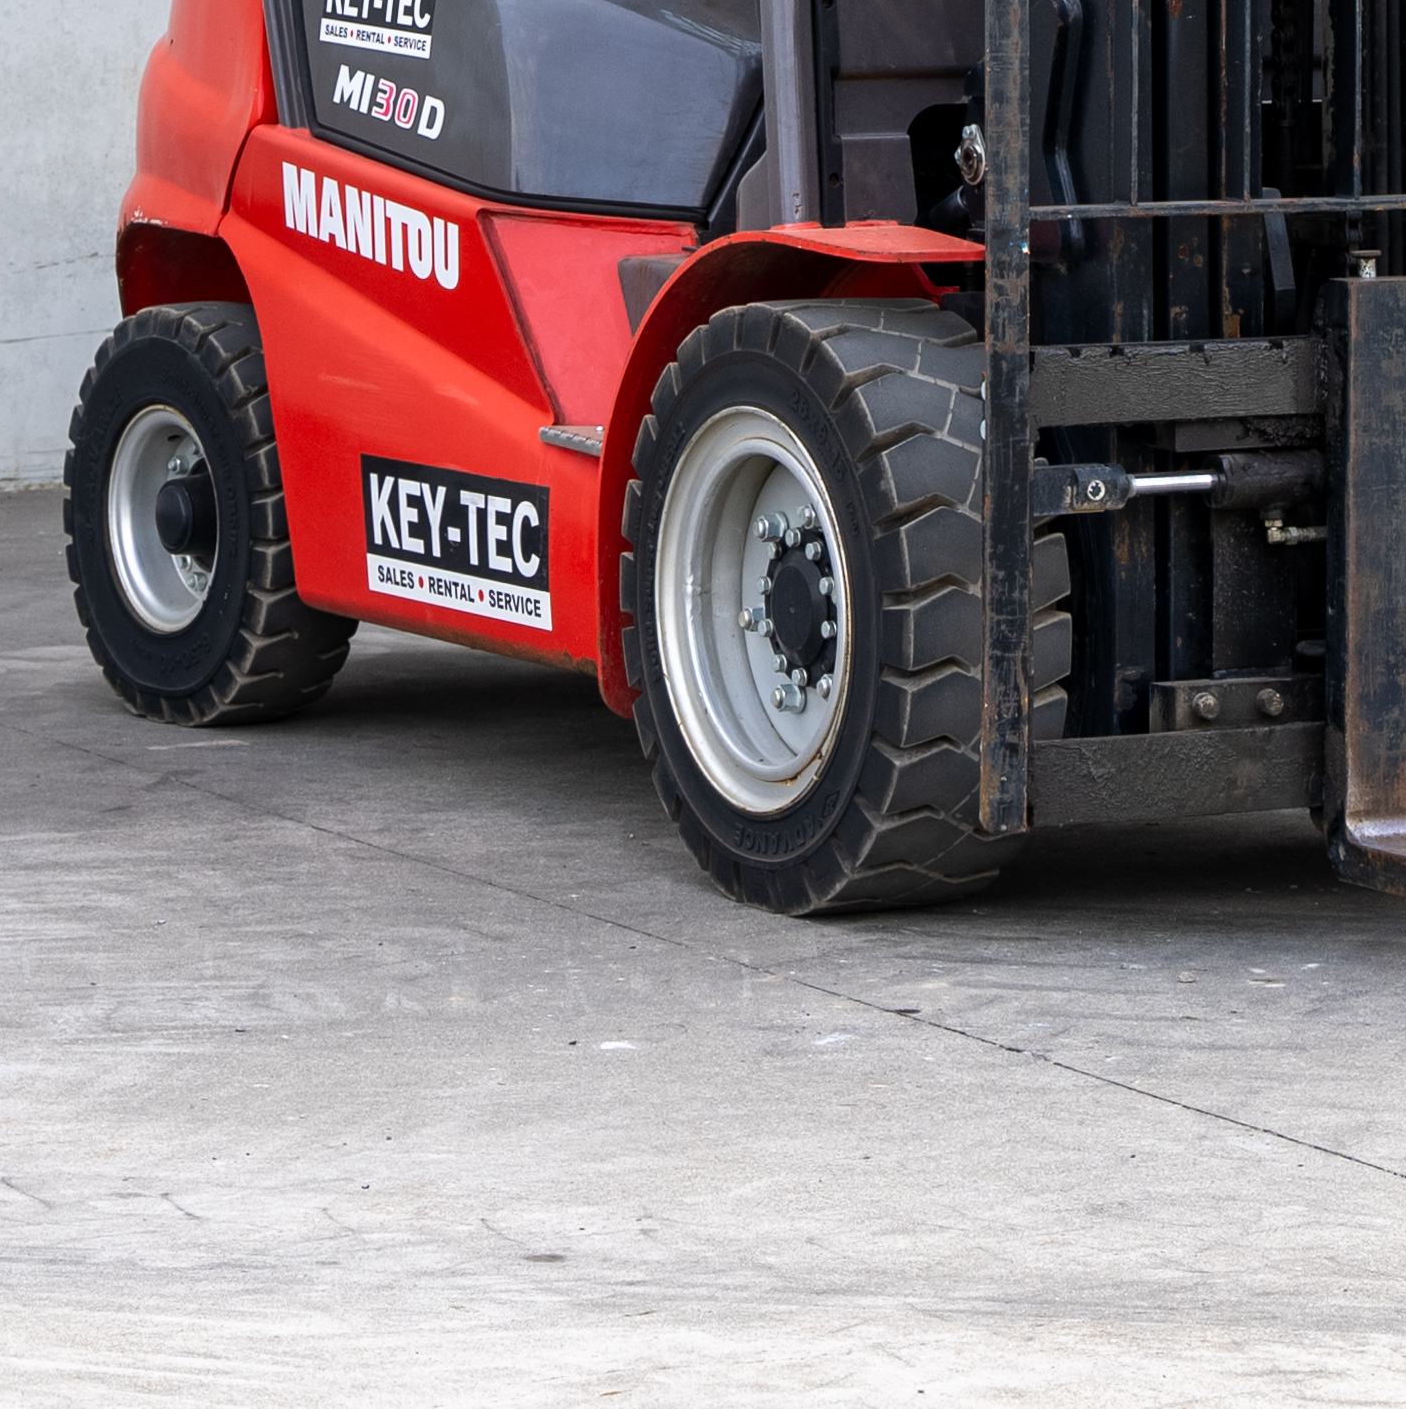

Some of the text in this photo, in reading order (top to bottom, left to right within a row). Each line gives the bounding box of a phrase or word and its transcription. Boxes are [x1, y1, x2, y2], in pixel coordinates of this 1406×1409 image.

[324, 24, 427, 52] SALES RENTAL SERVICE
[282, 161, 459, 290] MANITOU
[369, 472, 540, 578] KEY-TEC
[378, 564, 542, 618] SALES RENTAL SERVICE
[733, 815, 816, 855] ADVANCE
